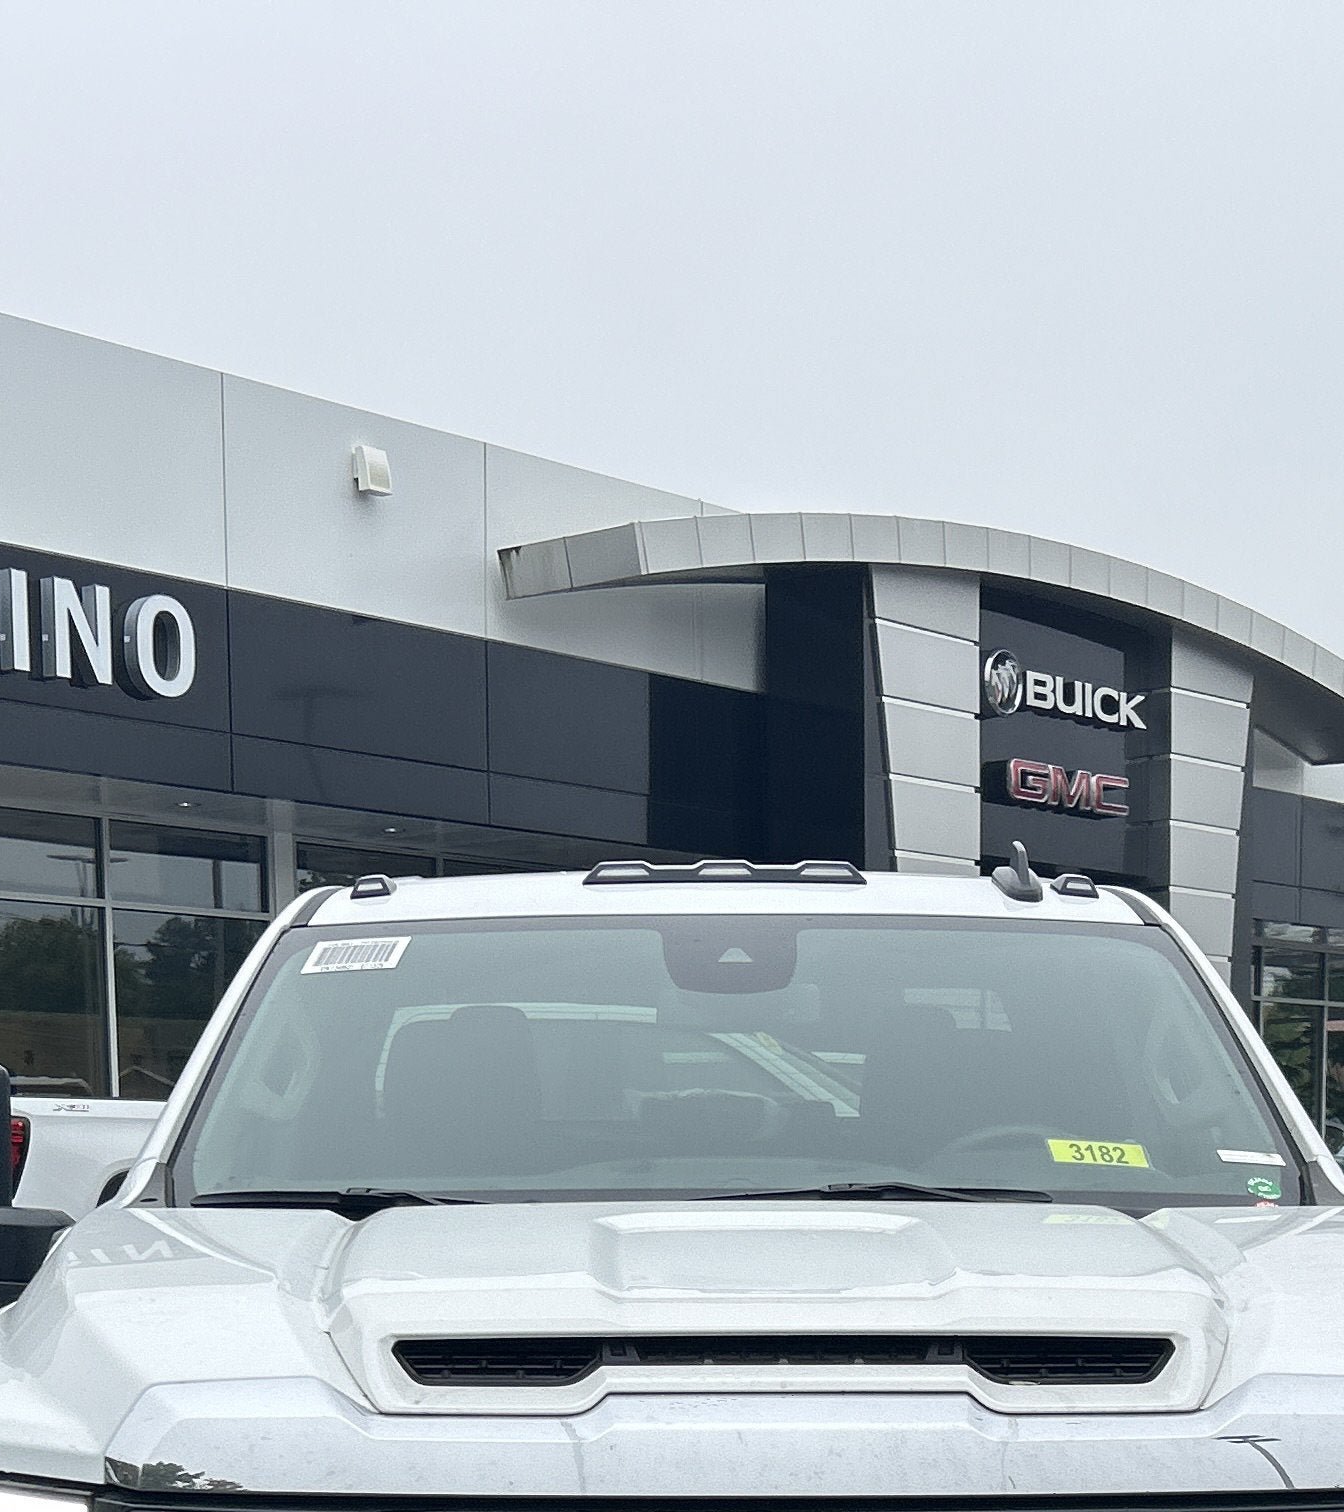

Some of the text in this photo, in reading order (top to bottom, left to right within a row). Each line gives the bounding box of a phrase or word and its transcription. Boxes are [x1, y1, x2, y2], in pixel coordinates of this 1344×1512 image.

[1025, 670, 1147, 730] BUICK
[1009, 758, 1129, 816] GMC
[1069, 1143, 1130, 1165] 3182
